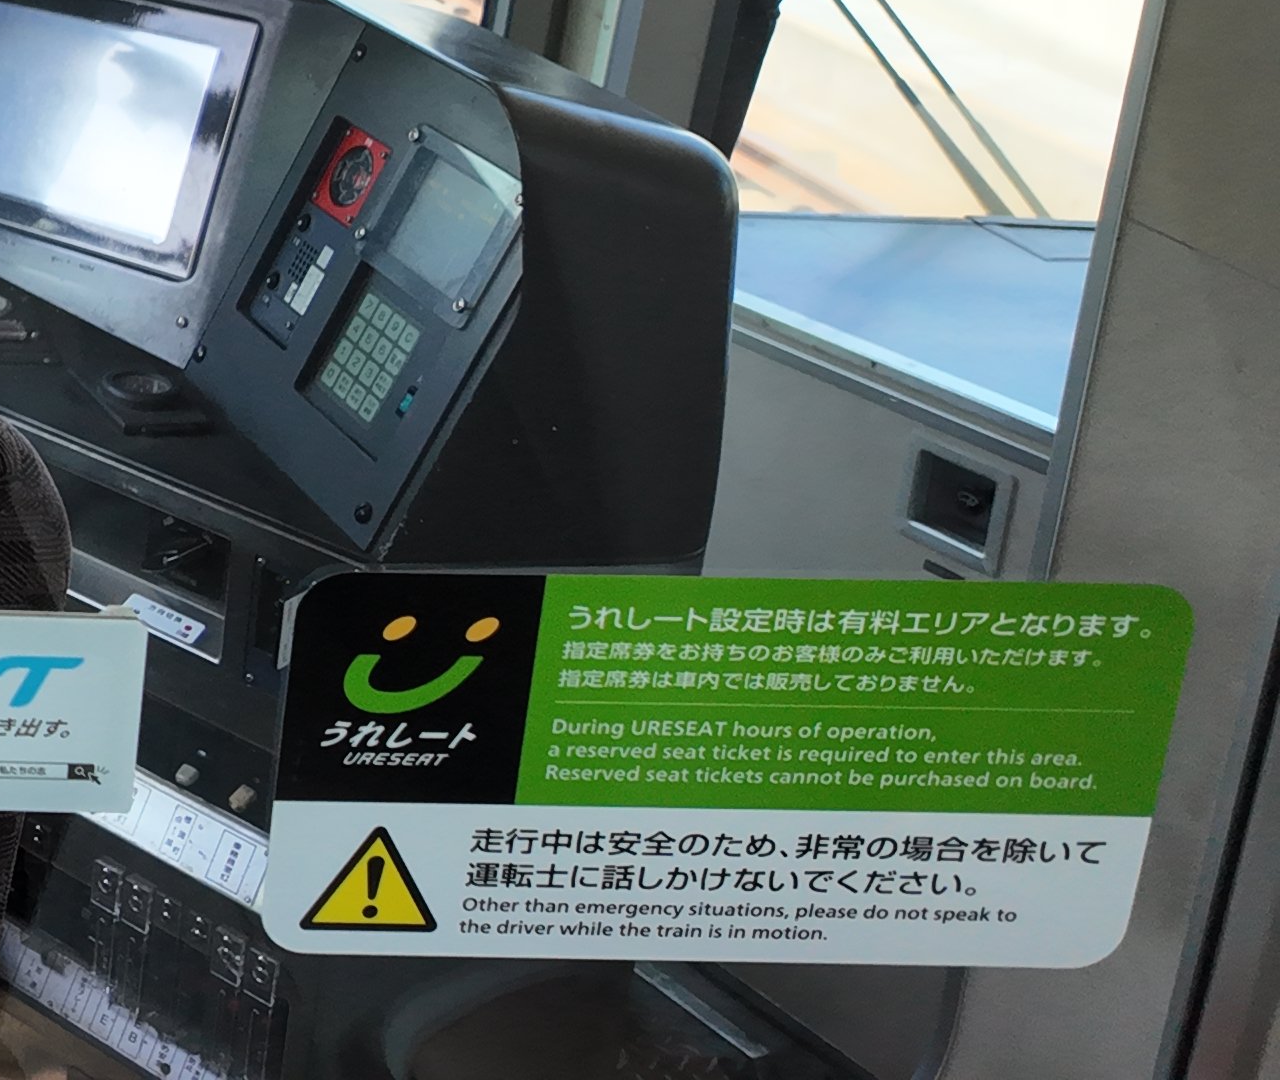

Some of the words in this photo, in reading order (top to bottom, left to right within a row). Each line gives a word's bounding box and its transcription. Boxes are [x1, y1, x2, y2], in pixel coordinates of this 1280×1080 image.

[568, 604, 1152, 639] うれしート設定時は有料エリアとなります。
[561, 640, 1102, 668] 指定席券をお持ちのお客様のみご利用いただけます。
[557, 668, 976, 694] 指定席券は車内では販売しておりません。
[551, 718, 625, 740] During
[631, 719, 728, 738] URESEAT
[732, 720, 793, 739] hours
[798, 721, 822, 739] of
[826, 724, 937, 744] operation,
[342, 751, 450, 767] URESEAT
[547, 745, 561, 758] a
[566, 742, 657, 760] reserved
[662, 745, 706, 760] seat
[711, 743, 772, 762] ticket
[776, 745, 793, 762] is
[798, 745, 890, 768] required
[895, 749, 918, 764] to
[923, 748, 981, 765] enter
[986, 747, 1025, 766] this
[1030, 752, 1083, 767] area.
[544, 764, 641, 783] Reserved
[645, 767, 690, 783] seat
[695, 766, 764, 785] tickets
[769, 769, 843, 786] cannot
[848, 768, 875, 787] be
[879, 769, 991, 790] purchased
[995, 775, 1023, 789] on
[1029, 771, 1098, 791] board.
[469, 827, 1108, 866] 走行中は安全のため、非常の場合を除いて
[465, 861, 978, 897] 運転士に話しかけないでください。
[462, 897, 520, 913] Other
[525, 898, 569, 914] than
[574, 902, 685, 918] emergency
[688, 901, 790, 920] situations,
[794, 903, 858, 922] please
[862, 904, 889, 921] do
[894, 906, 928, 922] not
[934, 905, 990, 925] speak
[996, 908, 1018, 923] to
[459, 918, 492, 935] the
[496, 919, 555, 936] driver
[559, 920, 614, 937] while
[619, 921, 651, 938] the
[656, 922, 702, 939] train
[707, 923, 723, 940] is
[727, 923, 747, 940] in
[751, 925, 829, 941] motion.
